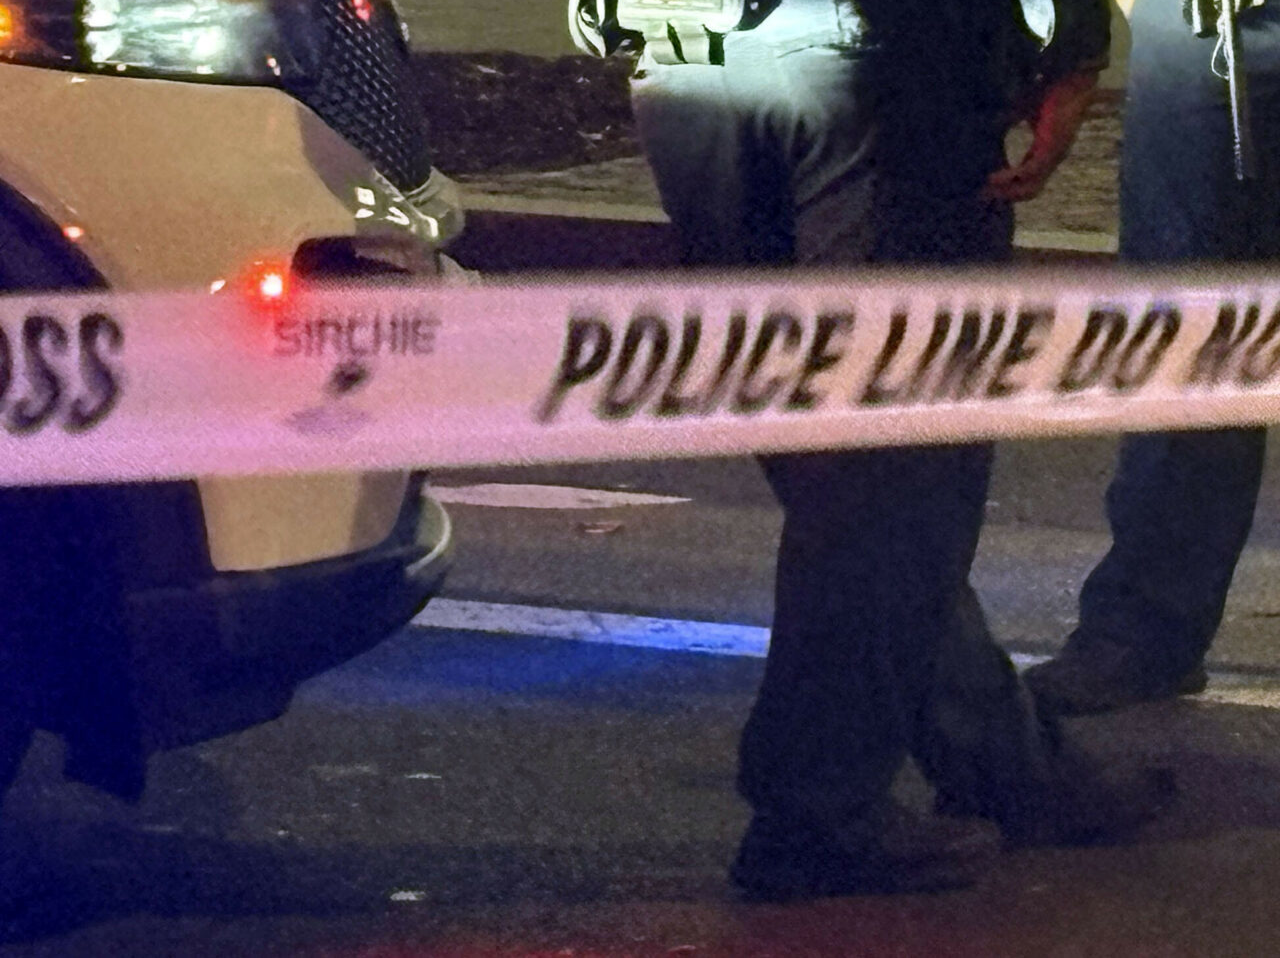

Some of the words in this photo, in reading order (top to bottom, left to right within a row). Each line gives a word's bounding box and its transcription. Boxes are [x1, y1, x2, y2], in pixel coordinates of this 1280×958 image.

[531, 304, 856, 424] POLICE
[853, 304, 1056, 408] LINE
[1056, 298, 1182, 394] DO
